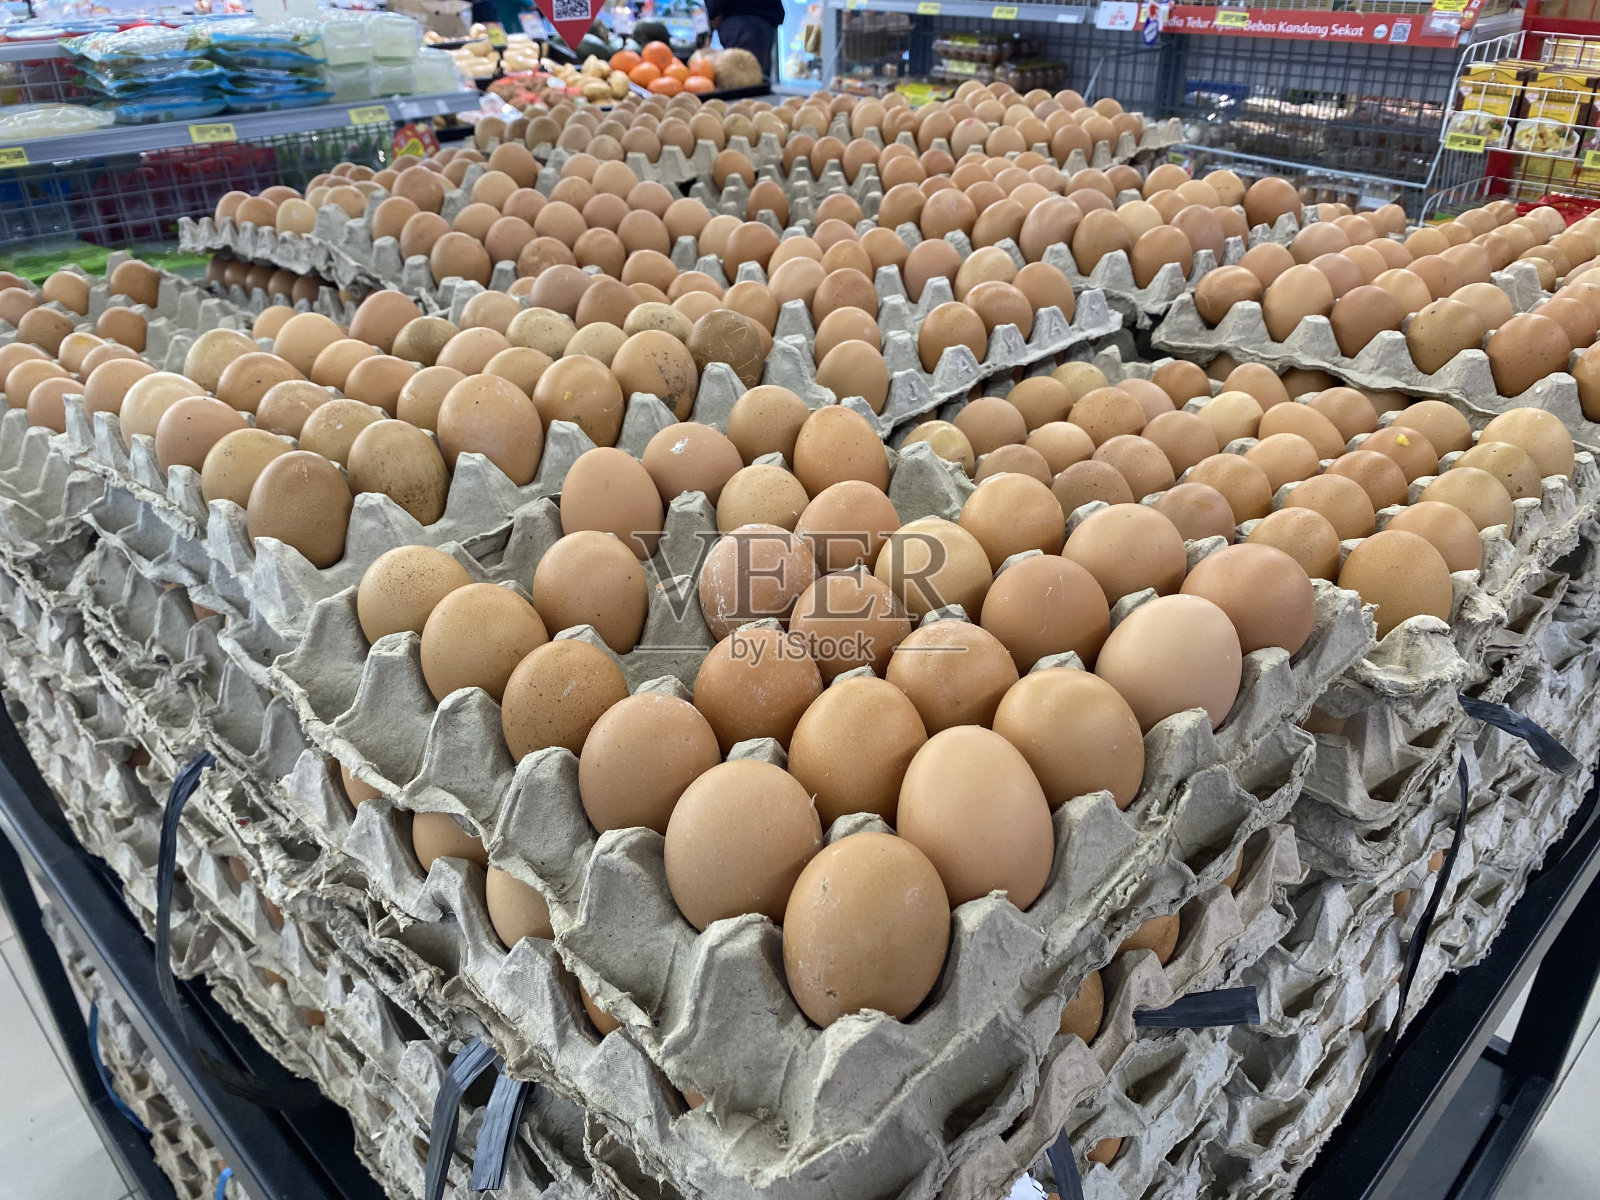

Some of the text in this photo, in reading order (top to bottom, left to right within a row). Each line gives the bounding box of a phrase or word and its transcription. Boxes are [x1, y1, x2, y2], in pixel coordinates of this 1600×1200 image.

[1186, 16, 1211, 28] Telur
[1245, 20, 1276, 32] Bebas
[1277, 21, 1328, 38] Kandang
[1331, 23, 1365, 36] Sekat
